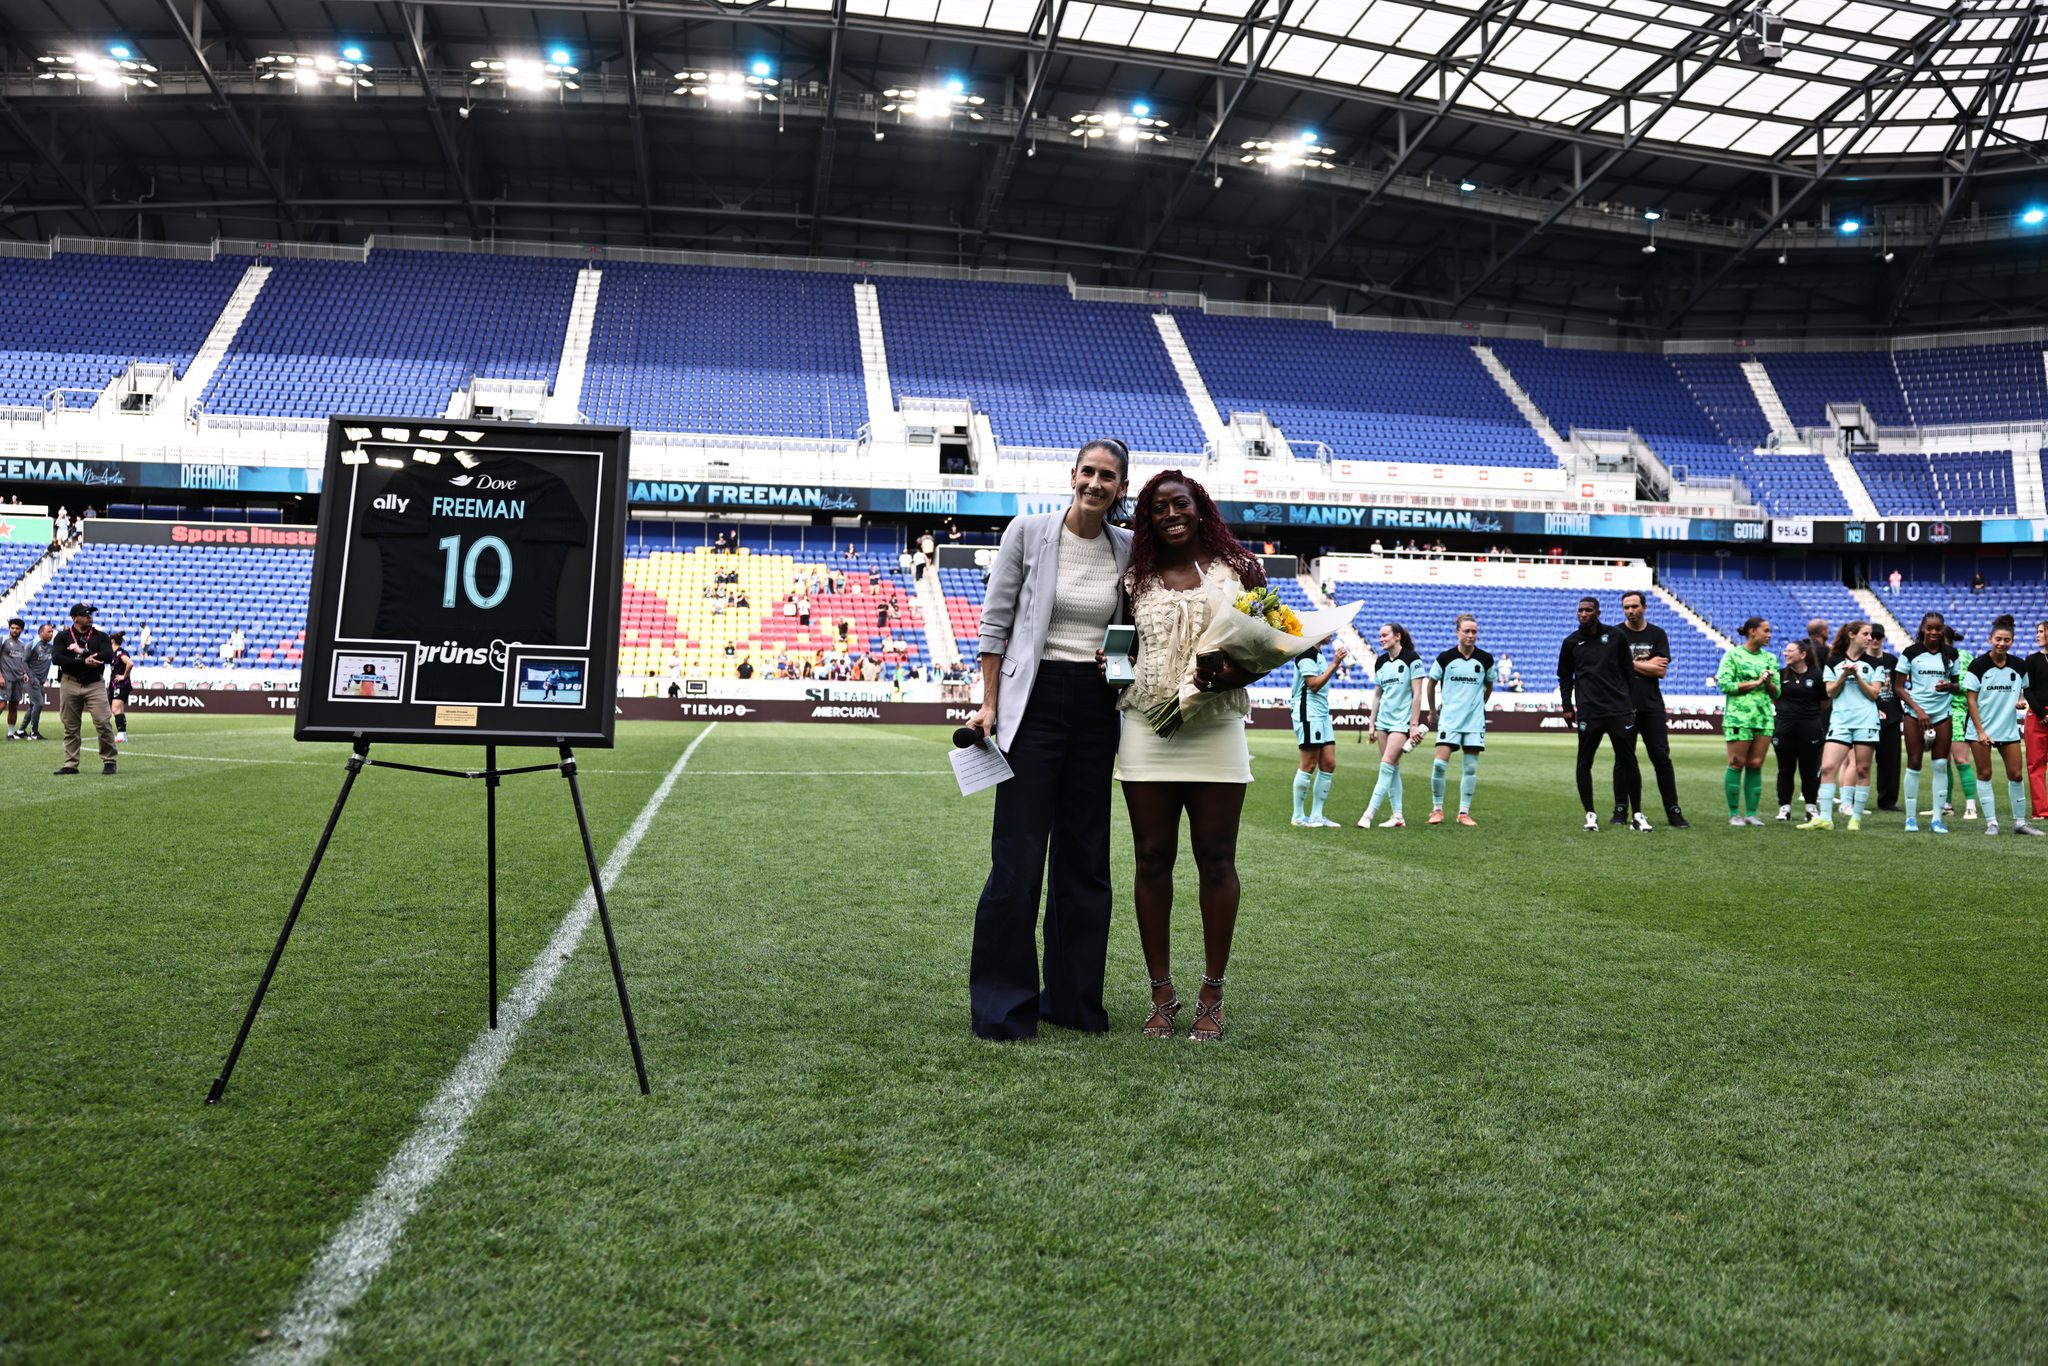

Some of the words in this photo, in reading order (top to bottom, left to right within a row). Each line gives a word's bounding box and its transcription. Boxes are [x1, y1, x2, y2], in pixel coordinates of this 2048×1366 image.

[181, 464, 238, 489] DEFENDER
[476, 474, 517, 491] Dove
[373, 494, 410, 513] ally
[708, 485, 821, 507] FREEMAN
[905, 489, 957, 513] DEFENDER
[431, 496, 525, 519] FREEMAN
[1243, 504, 1282, 523] #22
[1289, 506, 1365, 527] MANDY
[1371, 508, 1471, 529] FREEMAN
[172, 525, 248, 543] Sports
[1544, 513, 1591, 535] DEFENDER
[1777, 526, 1808, 537] 95:45
[439, 534, 513, 609] 10
[418, 640, 488, 666] grüns
[128, 695, 205, 708] PHANTOM
[805, 688, 829, 701] SI
[680, 704, 757, 716] TIEMPO
[811, 706, 880, 718] MERCURIAL
